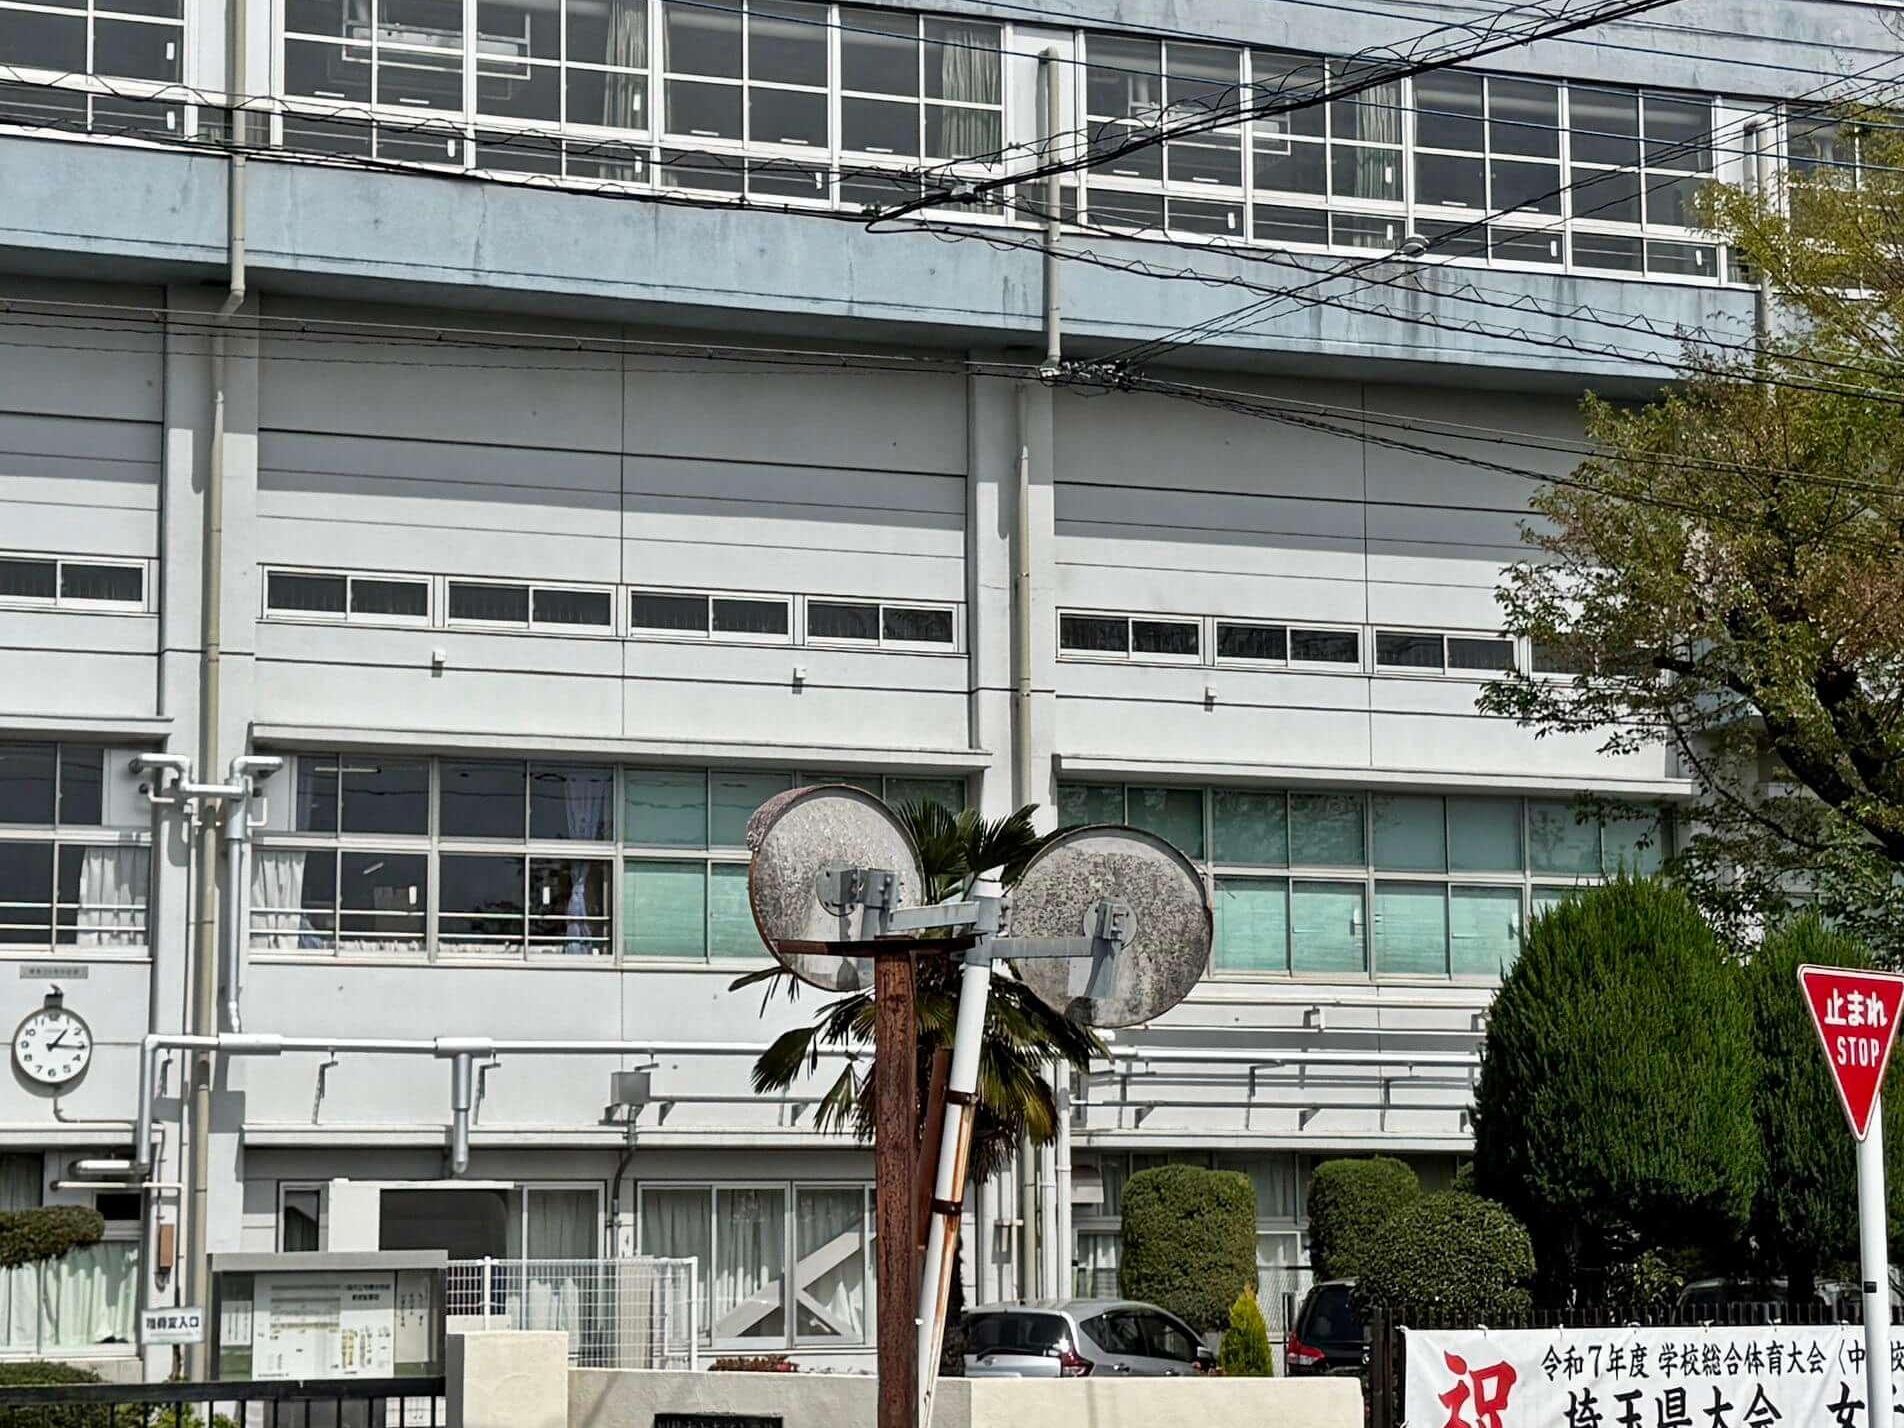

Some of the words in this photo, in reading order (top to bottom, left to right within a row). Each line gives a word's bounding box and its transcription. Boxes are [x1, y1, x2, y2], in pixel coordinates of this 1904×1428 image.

[1824, 988, 1888, 1029] 止まれ
[1837, 1035, 1881, 1068] STOP
[1541, 1342, 1648, 1381] 令和7年度
[1658, 1340, 1827, 1379] 学校総合体育大会
